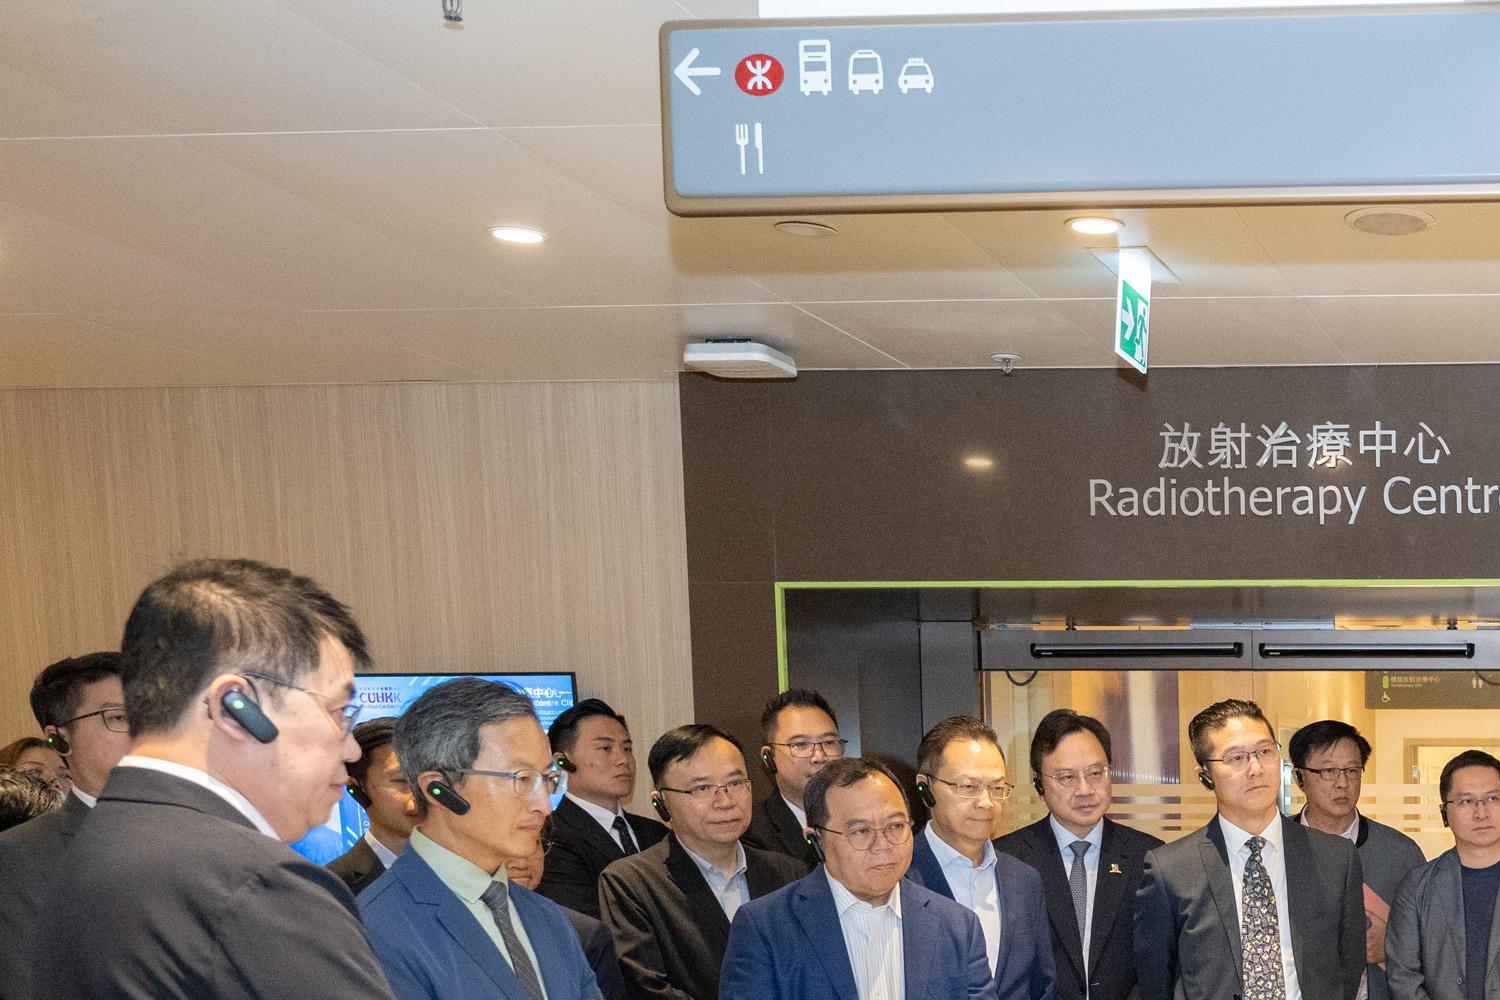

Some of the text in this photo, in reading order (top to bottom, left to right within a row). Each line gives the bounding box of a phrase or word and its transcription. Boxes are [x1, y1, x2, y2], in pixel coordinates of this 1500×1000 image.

[1158, 420, 1452, 470] 放射治療中心
[1088, 475, 1367, 525] Radiotherapy
